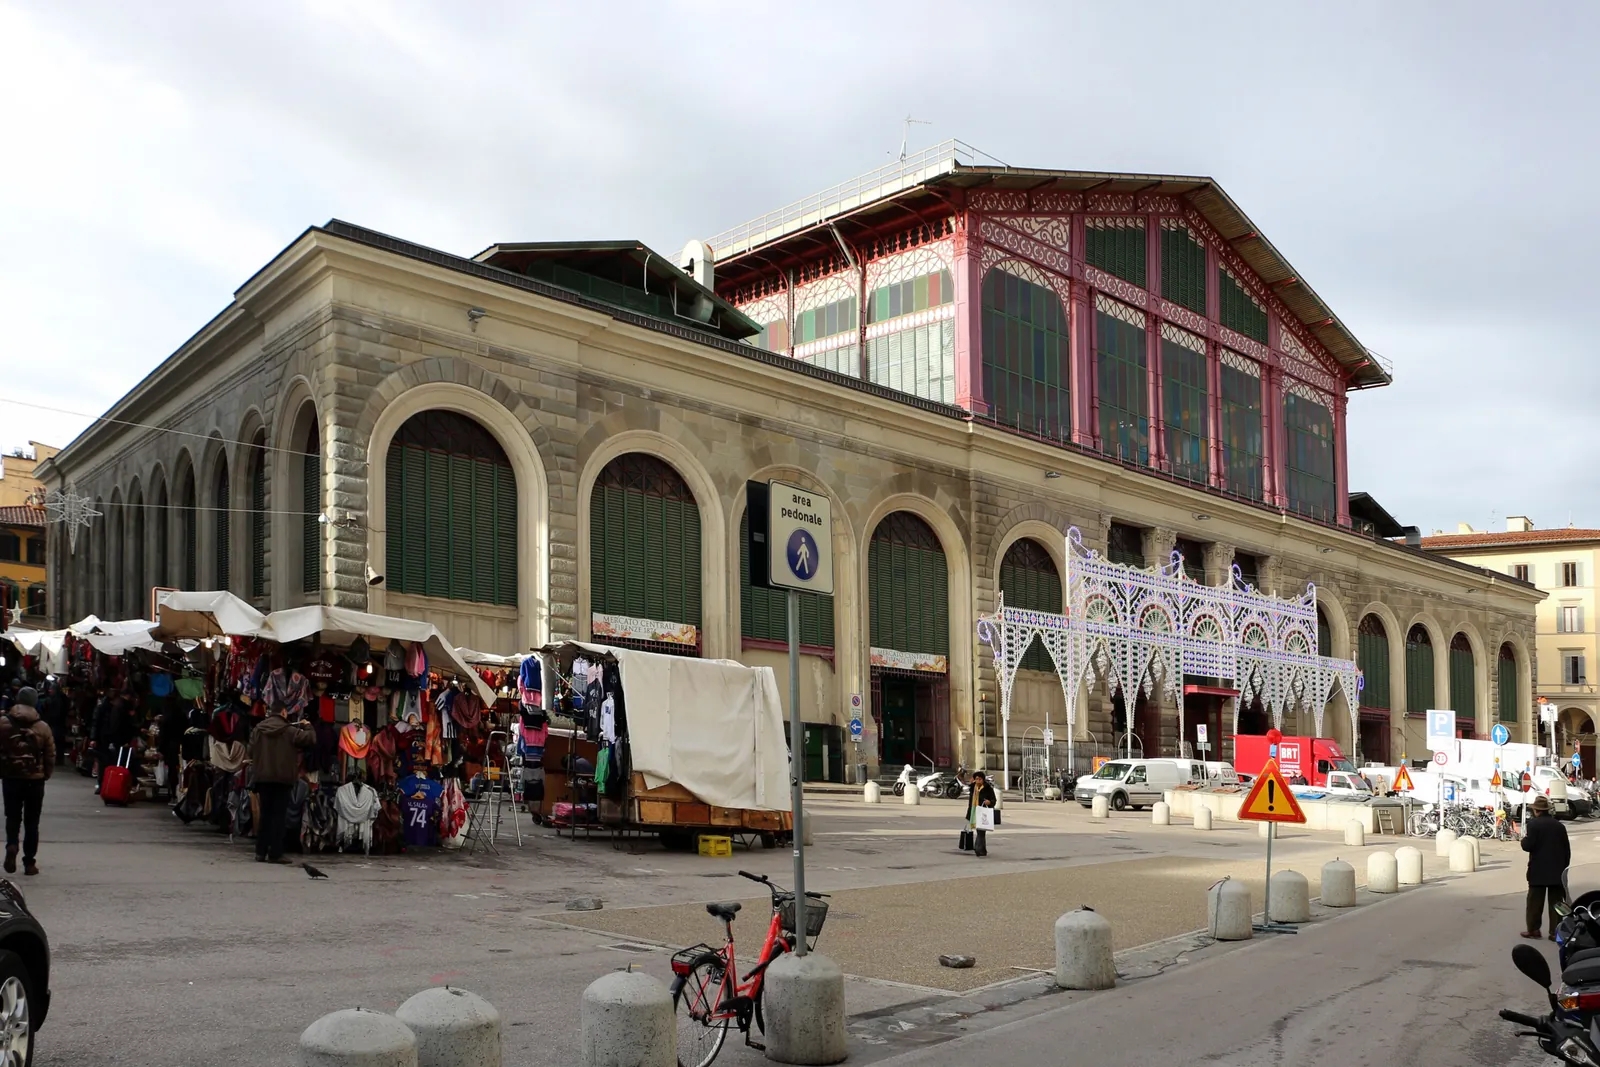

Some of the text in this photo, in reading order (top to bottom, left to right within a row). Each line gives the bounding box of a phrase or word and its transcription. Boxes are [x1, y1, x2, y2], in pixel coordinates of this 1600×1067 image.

[792, 494, 811, 507] area
[781, 507, 822, 526] pedonale
[603, 616, 676, 630] MERCATO CENTRALE
[615, 623, 642, 632] FIRENZE
[1435, 713, 1448, 730] P
[1281, 747, 1298, 759] BRT
[1444, 787, 1453, 799] P
[410, 807, 427, 828] 74
